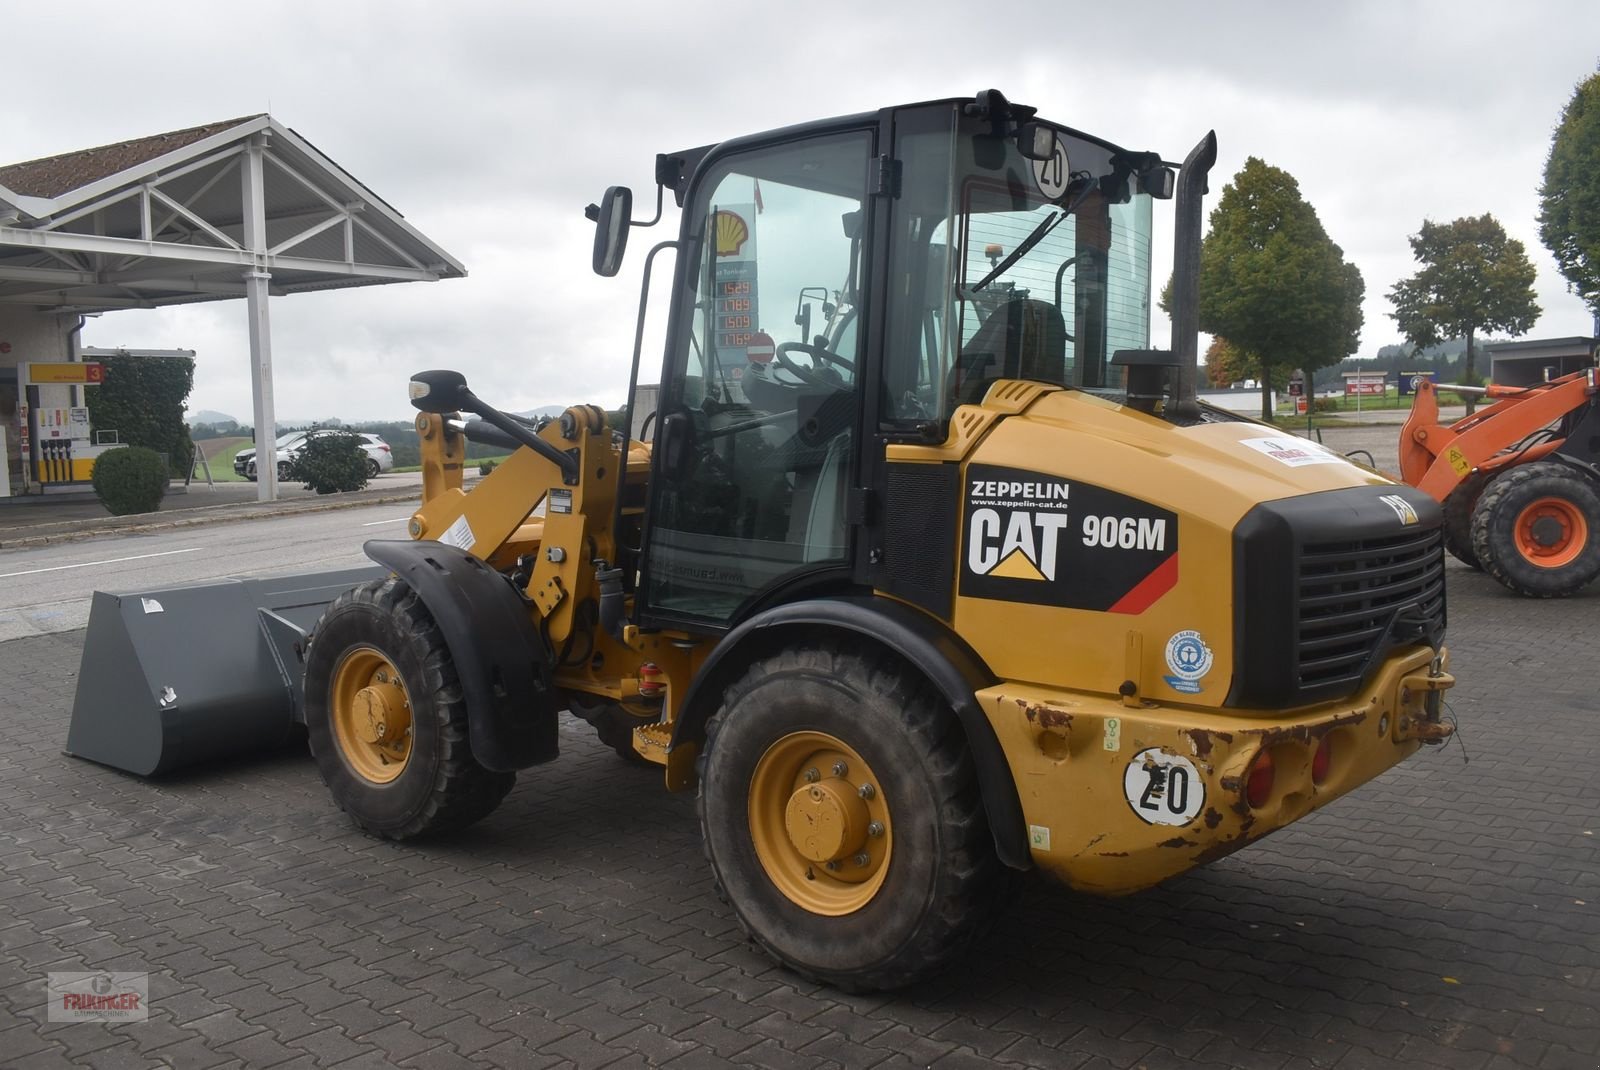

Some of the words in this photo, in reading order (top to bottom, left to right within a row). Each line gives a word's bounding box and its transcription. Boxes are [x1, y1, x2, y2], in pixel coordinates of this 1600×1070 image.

[91, 367, 100, 380] 3
[971, 480, 1070, 500] ZEPPELIN
[971, 499, 1068, 510] www.zeppelin-cat.de
[1082, 515, 1166, 551] 906M
[968, 508, 1068, 582] CAT
